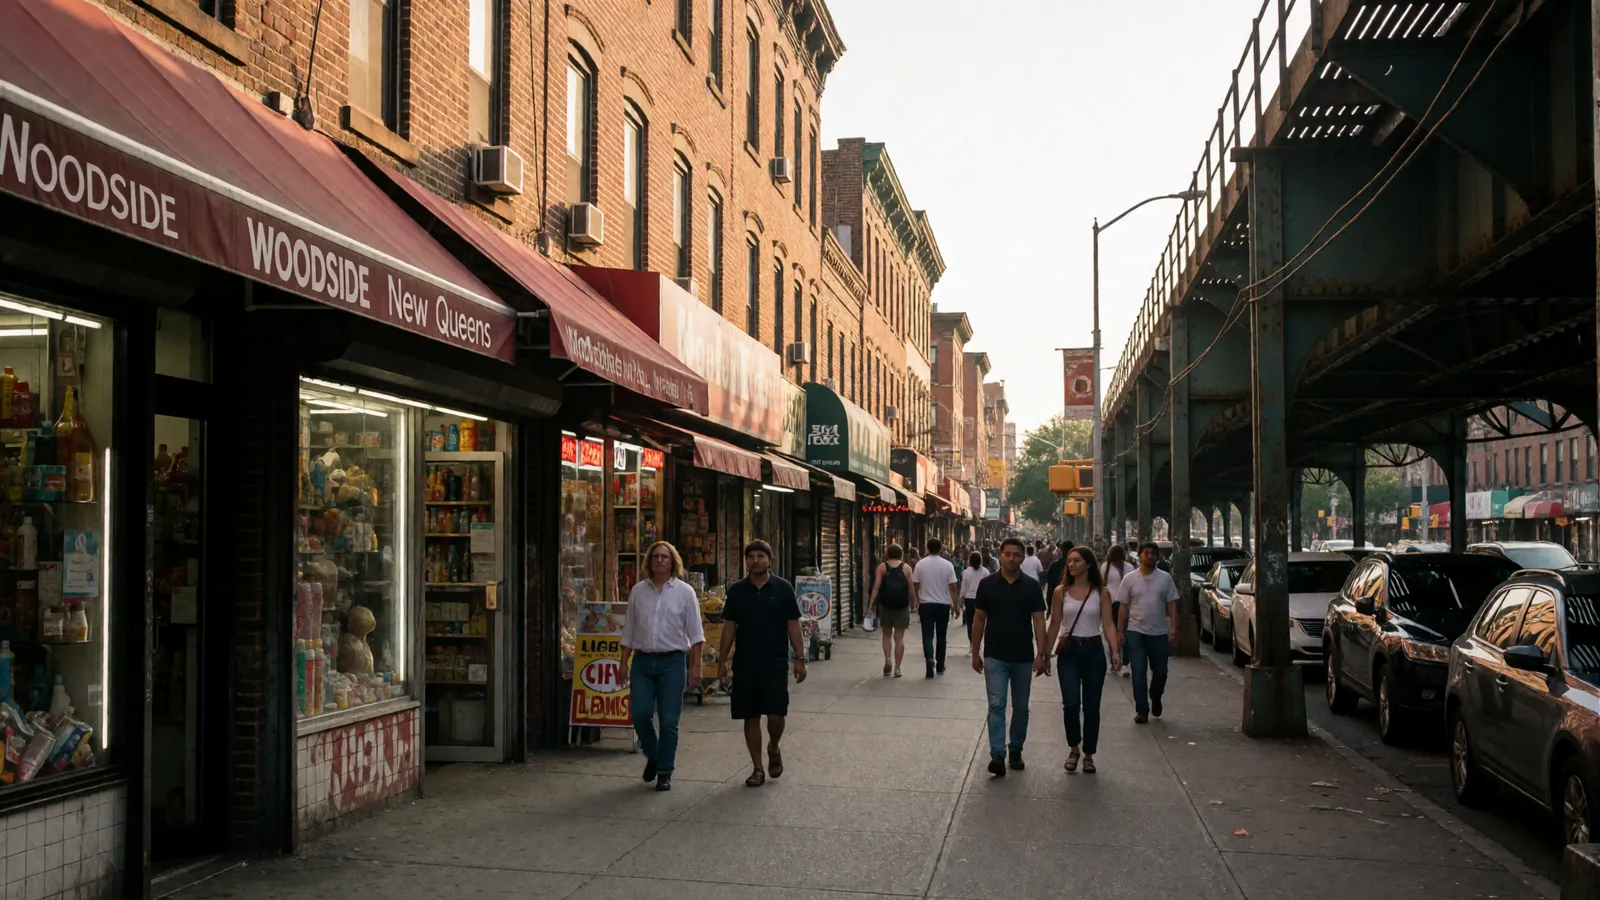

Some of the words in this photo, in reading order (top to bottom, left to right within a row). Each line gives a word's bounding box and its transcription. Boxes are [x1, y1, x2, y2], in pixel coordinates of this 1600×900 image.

[246, 216, 371, 309] WOODSIDE
[387, 274, 428, 328] New
[435, 295, 491, 349] Queens
